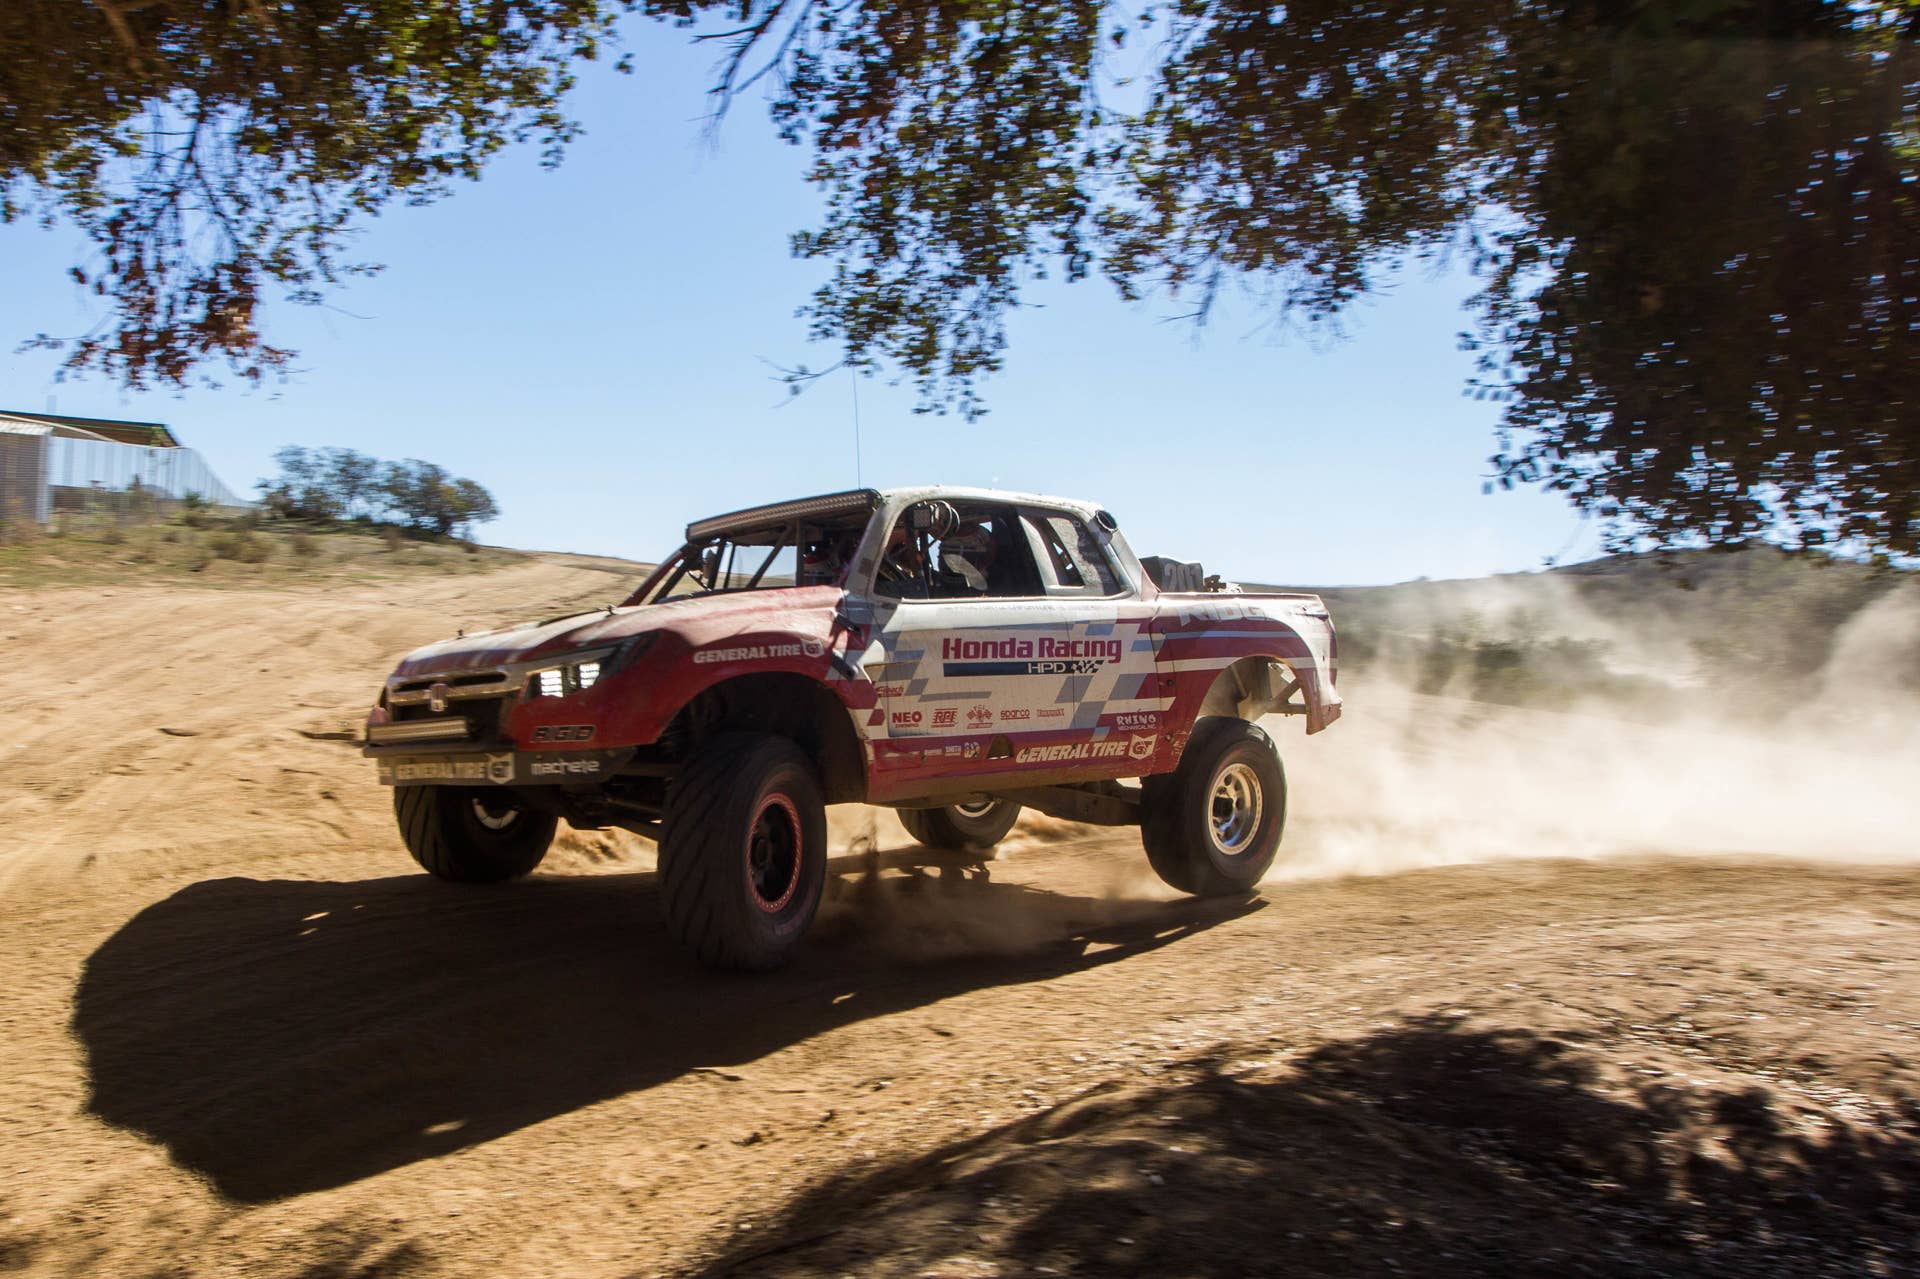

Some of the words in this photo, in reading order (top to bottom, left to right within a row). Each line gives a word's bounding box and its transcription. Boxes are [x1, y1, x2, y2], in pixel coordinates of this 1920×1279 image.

[693, 647, 767, 664] GENERAL
[768, 644, 800, 657] TIRE
[943, 638, 1033, 659] Honda
[1038, 638, 1122, 663] Racing
[1028, 663, 1066, 674] HPD
[892, 711, 922, 723] NEO
[1001, 709, 1030, 719] sparco
[1116, 714, 1157, 726] RHINO
[1015, 743, 1089, 763] GENERAL
[1090, 741, 1128, 757] TIRE
[531, 757, 600, 776] machete
